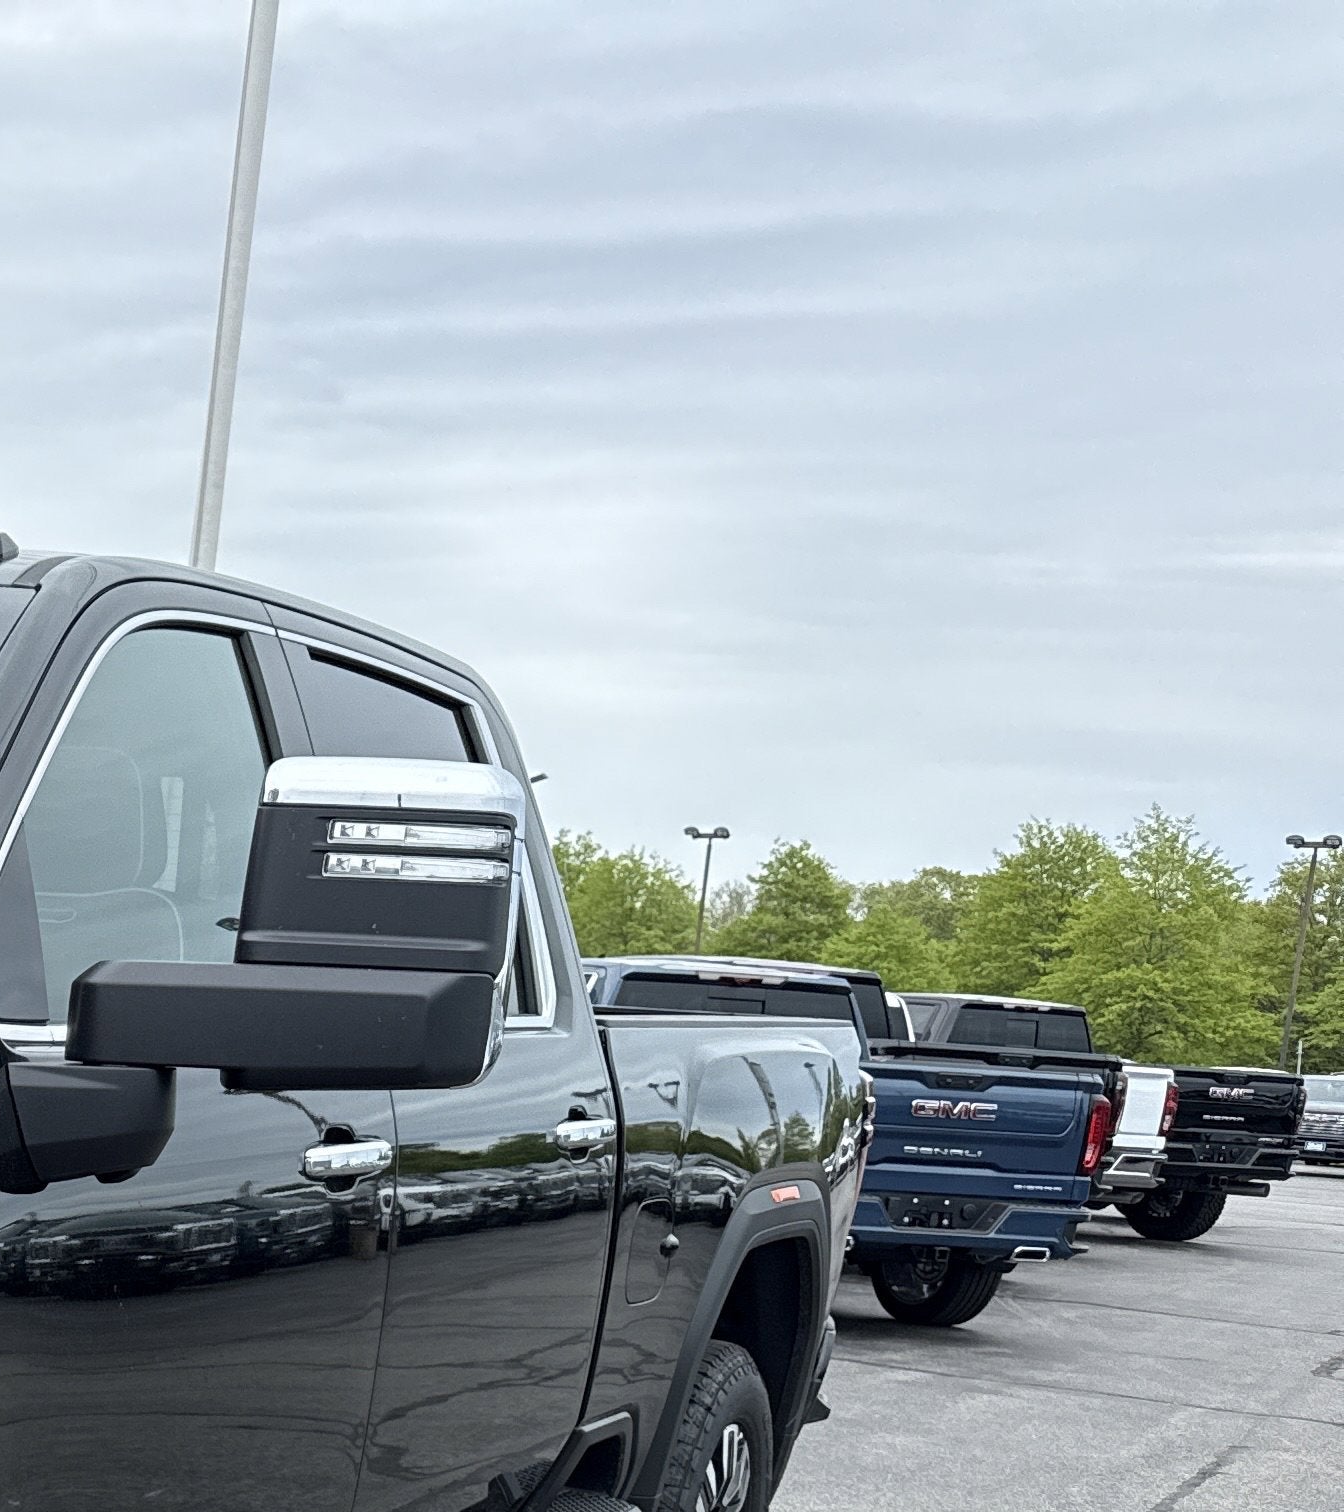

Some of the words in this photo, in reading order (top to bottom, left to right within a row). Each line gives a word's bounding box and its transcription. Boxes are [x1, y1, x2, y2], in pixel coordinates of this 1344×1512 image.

[1208, 1086, 1255, 1099] GMC
[911, 1098, 999, 1122] GMC
[903, 1145, 983, 1158] DENALI
